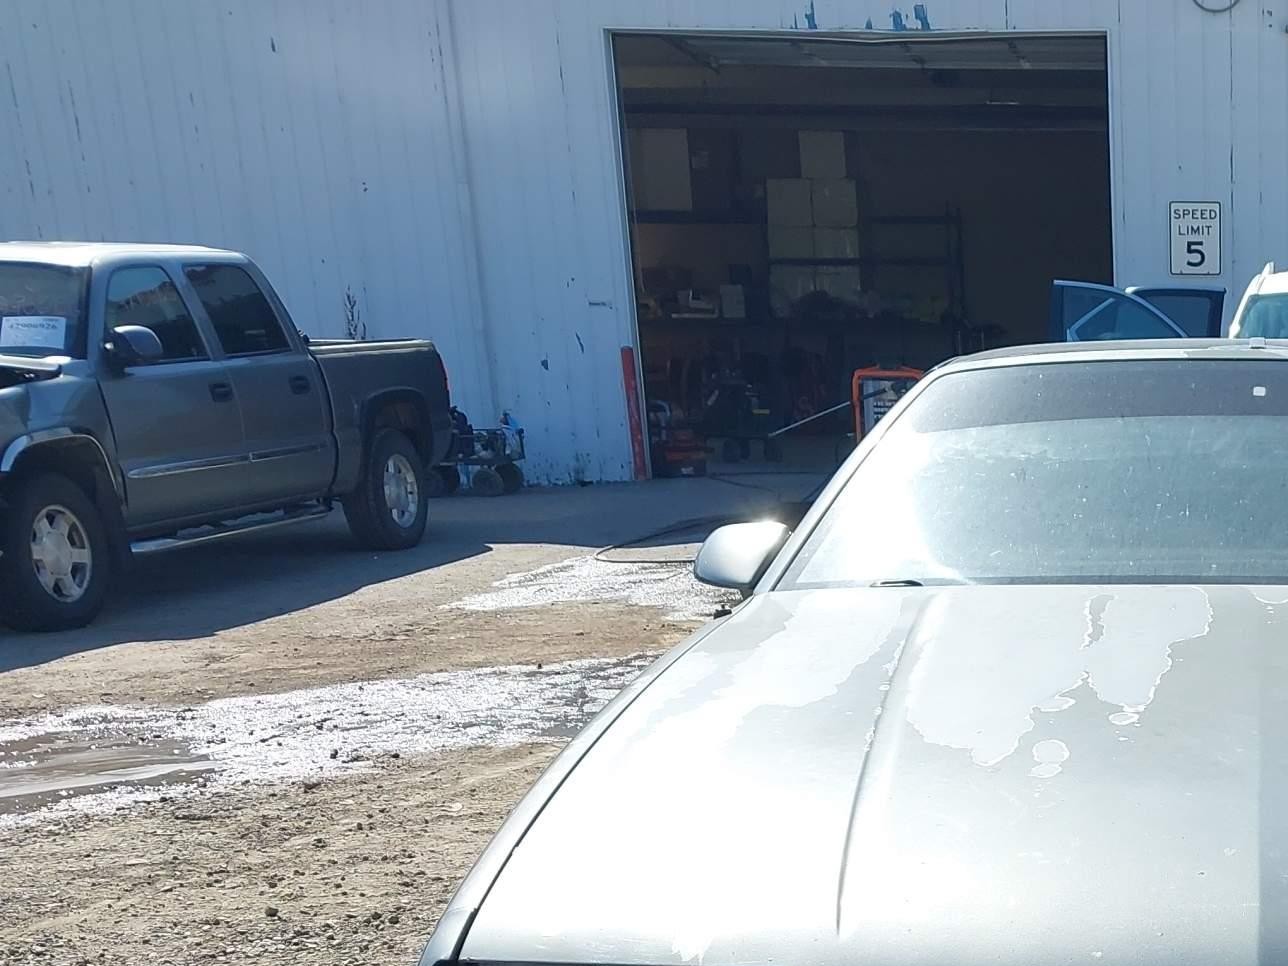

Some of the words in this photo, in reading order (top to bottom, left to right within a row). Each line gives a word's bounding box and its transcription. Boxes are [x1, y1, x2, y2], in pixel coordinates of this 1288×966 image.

[1173, 209, 1217, 220] SPEED
[1178, 225, 1212, 236] LIMIT
[1186, 241, 1206, 267] 5
